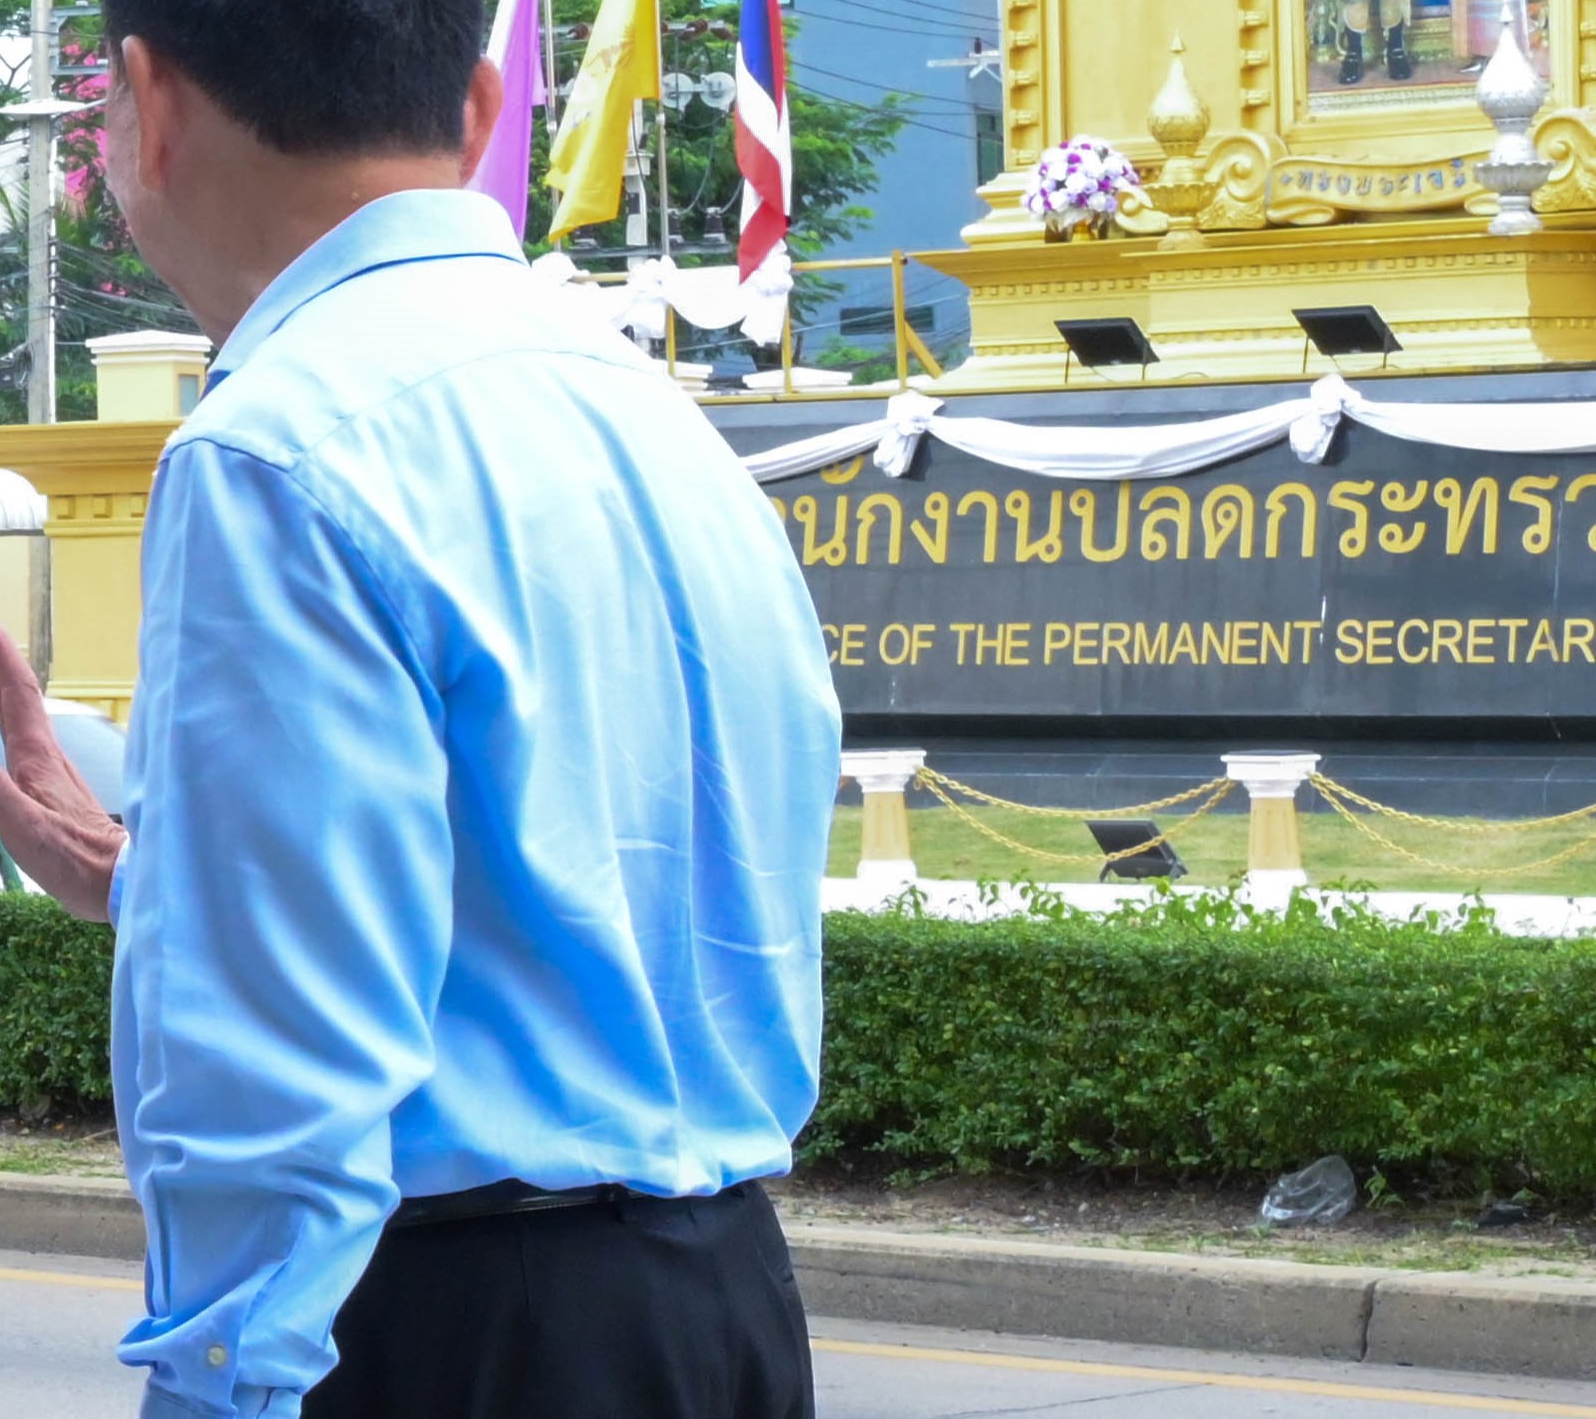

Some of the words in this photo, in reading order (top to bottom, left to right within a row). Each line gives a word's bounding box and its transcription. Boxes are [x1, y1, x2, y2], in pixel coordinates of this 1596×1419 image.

[879, 623, 936, 665] OF
[949, 622, 1031, 665] THE
[1044, 620, 1322, 665] PERMANENT
[1335, 618, 1596, 664] SECRETAR
